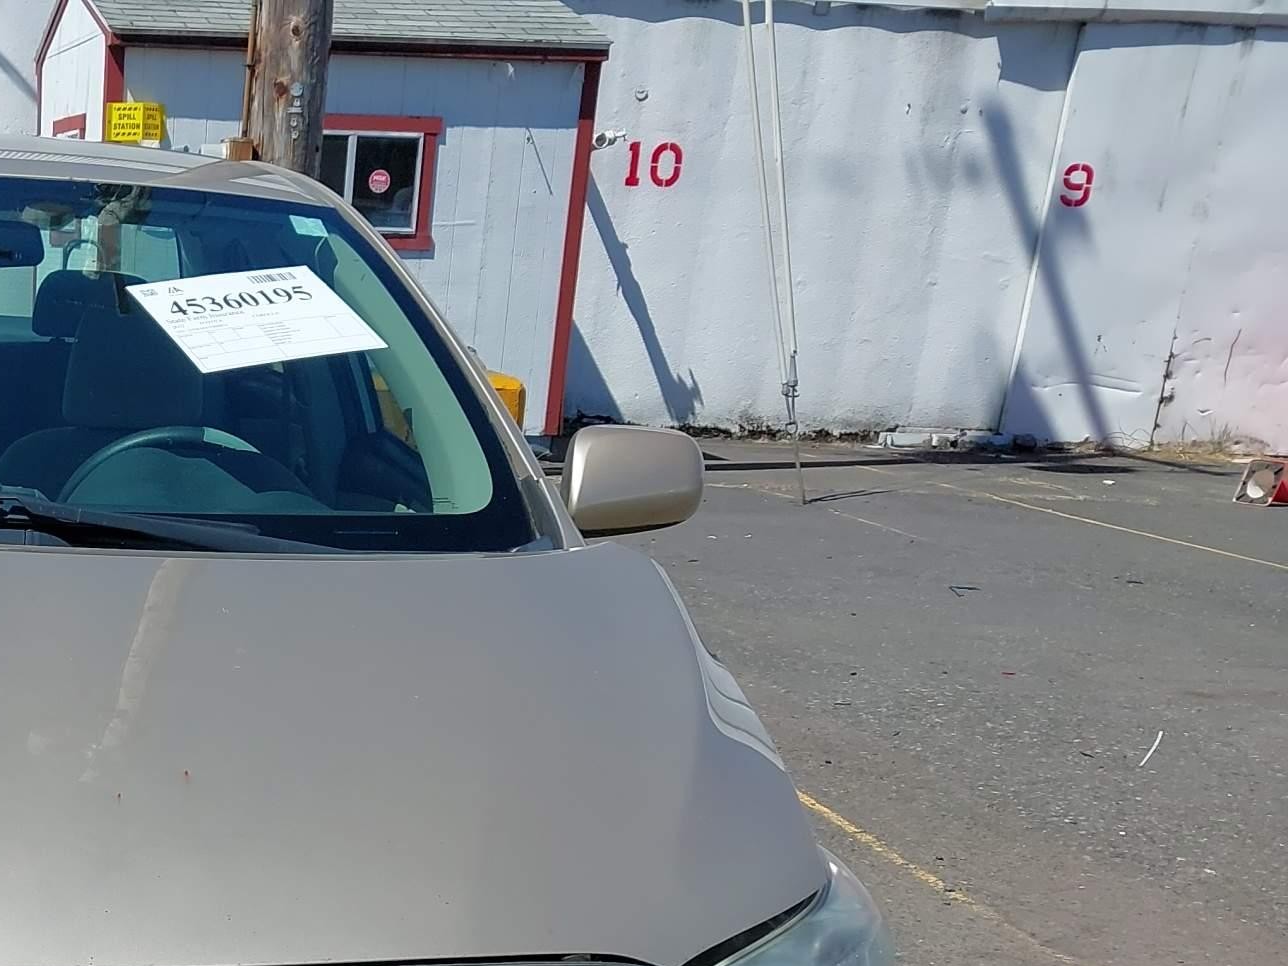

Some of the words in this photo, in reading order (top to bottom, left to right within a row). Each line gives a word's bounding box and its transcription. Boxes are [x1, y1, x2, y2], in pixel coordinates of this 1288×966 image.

[113, 122, 141, 130] STATION
[118, 113, 137, 121] SPILL
[624, 141, 683, 188] 10
[1059, 163, 1095, 208] 9
[170, 285, 313, 316] 45360195
